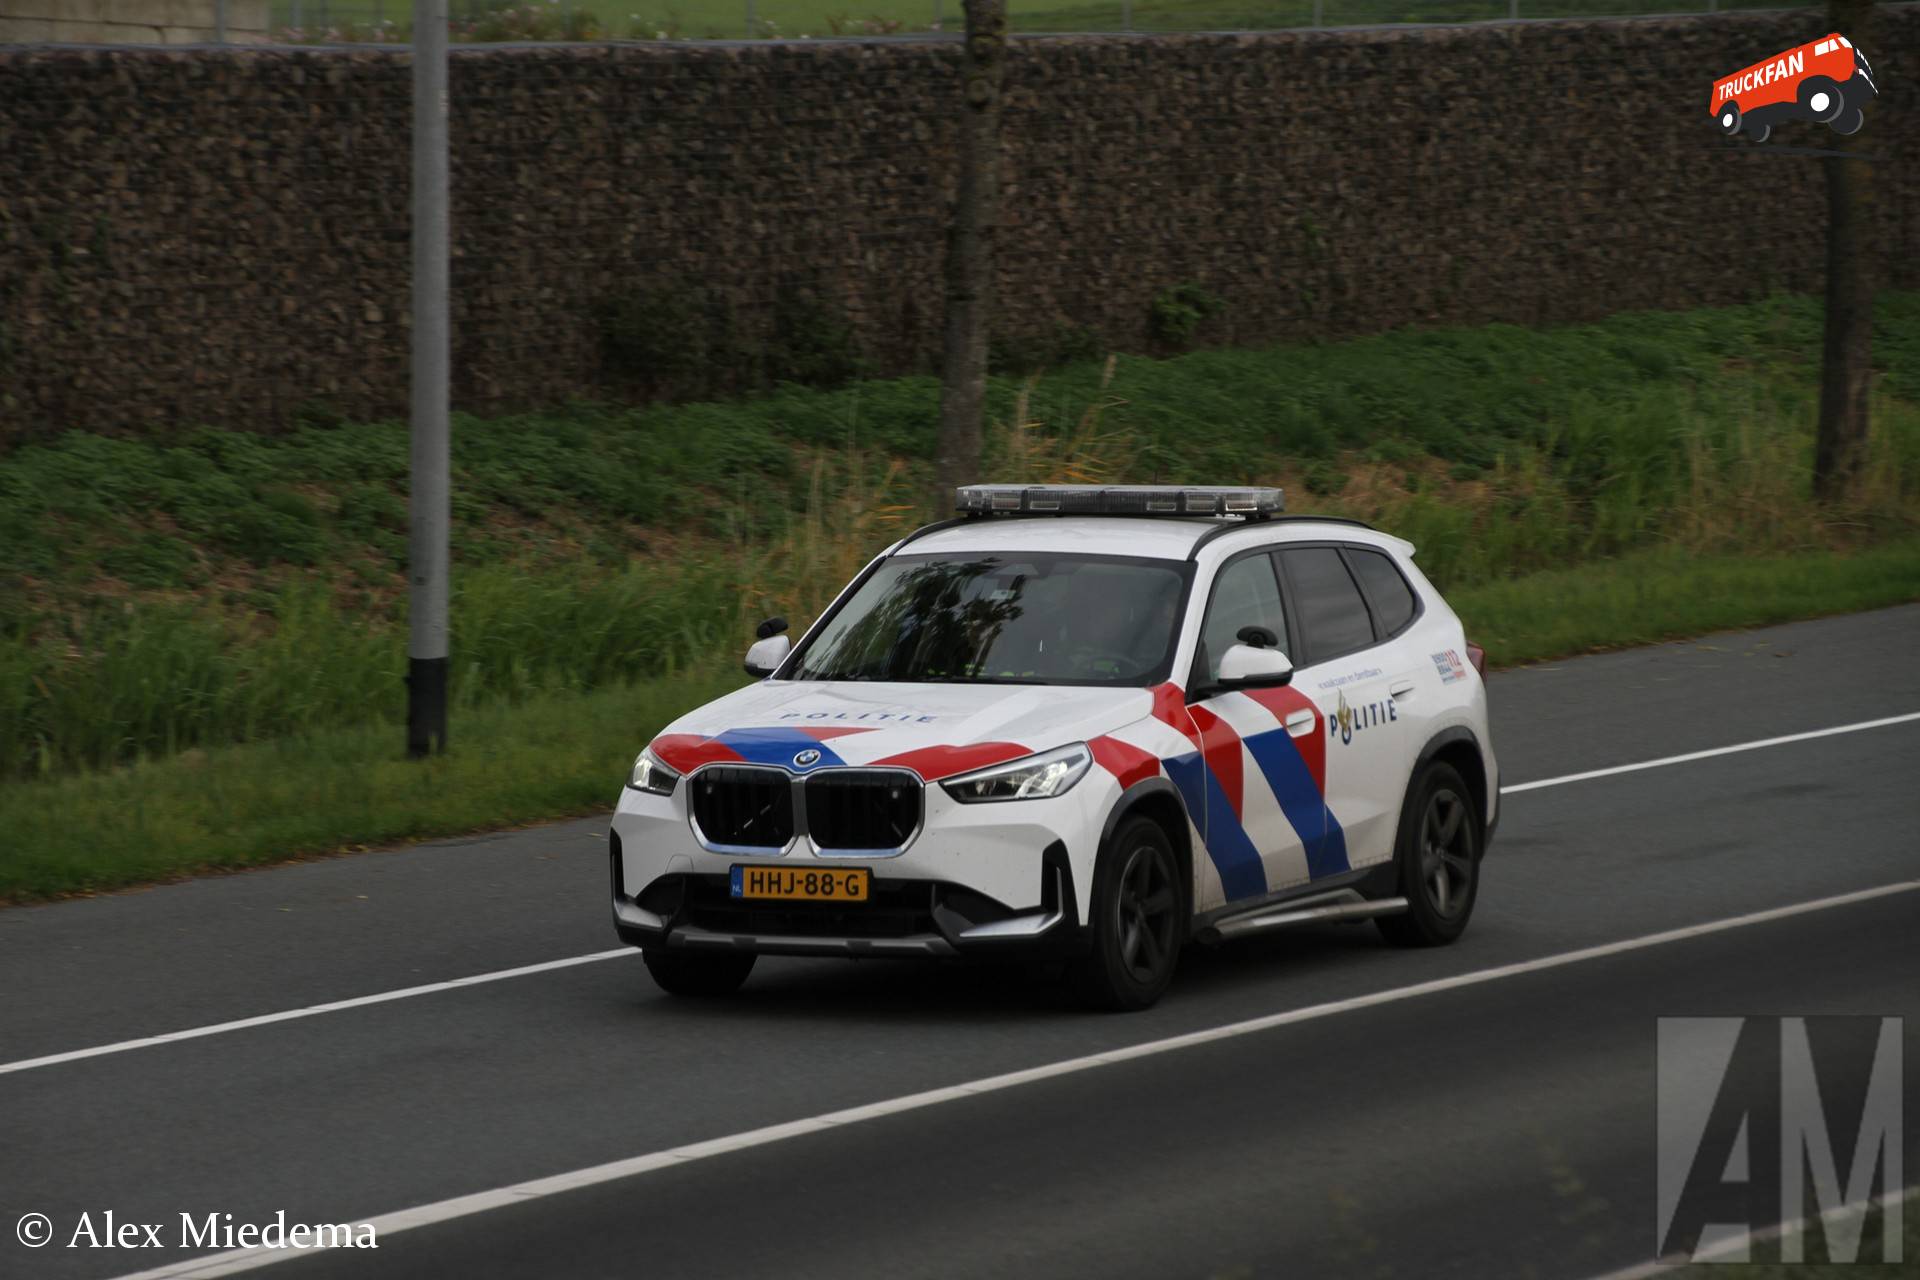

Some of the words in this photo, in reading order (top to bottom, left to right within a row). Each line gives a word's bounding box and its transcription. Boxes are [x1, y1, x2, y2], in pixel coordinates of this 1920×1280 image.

[779, 712, 938, 724] POLITIE
[1329, 699, 1398, 745] POLITIE
[750, 871, 860, 896] HHJ-88-G
